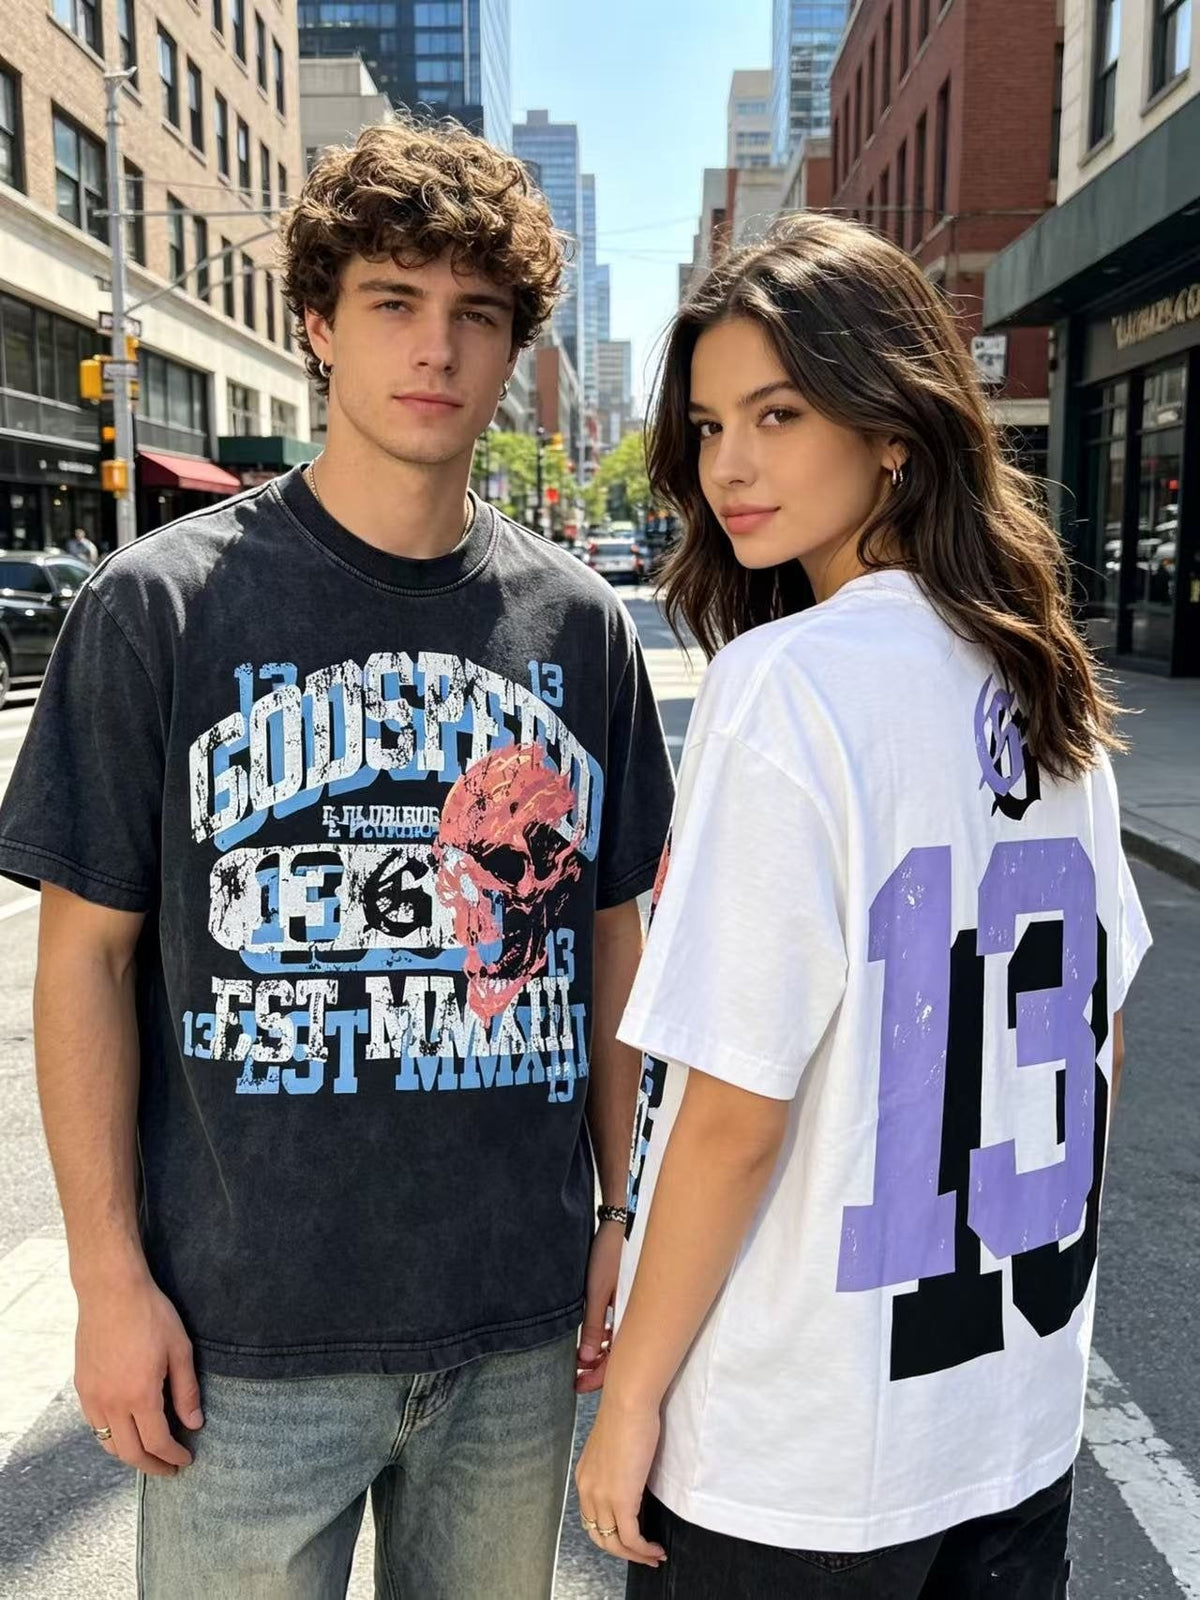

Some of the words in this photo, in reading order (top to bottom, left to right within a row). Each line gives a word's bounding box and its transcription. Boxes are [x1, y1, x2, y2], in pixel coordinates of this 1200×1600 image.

[528, 660, 563, 707] 13
[251, 851, 344, 944] 13
[545, 928, 575, 982] 13
[182, 1010, 216, 1060] 13
[211, 976, 338, 1062] EST
[365, 976, 574, 1060] MMXIII
[836, 836, 1097, 1293] 13
